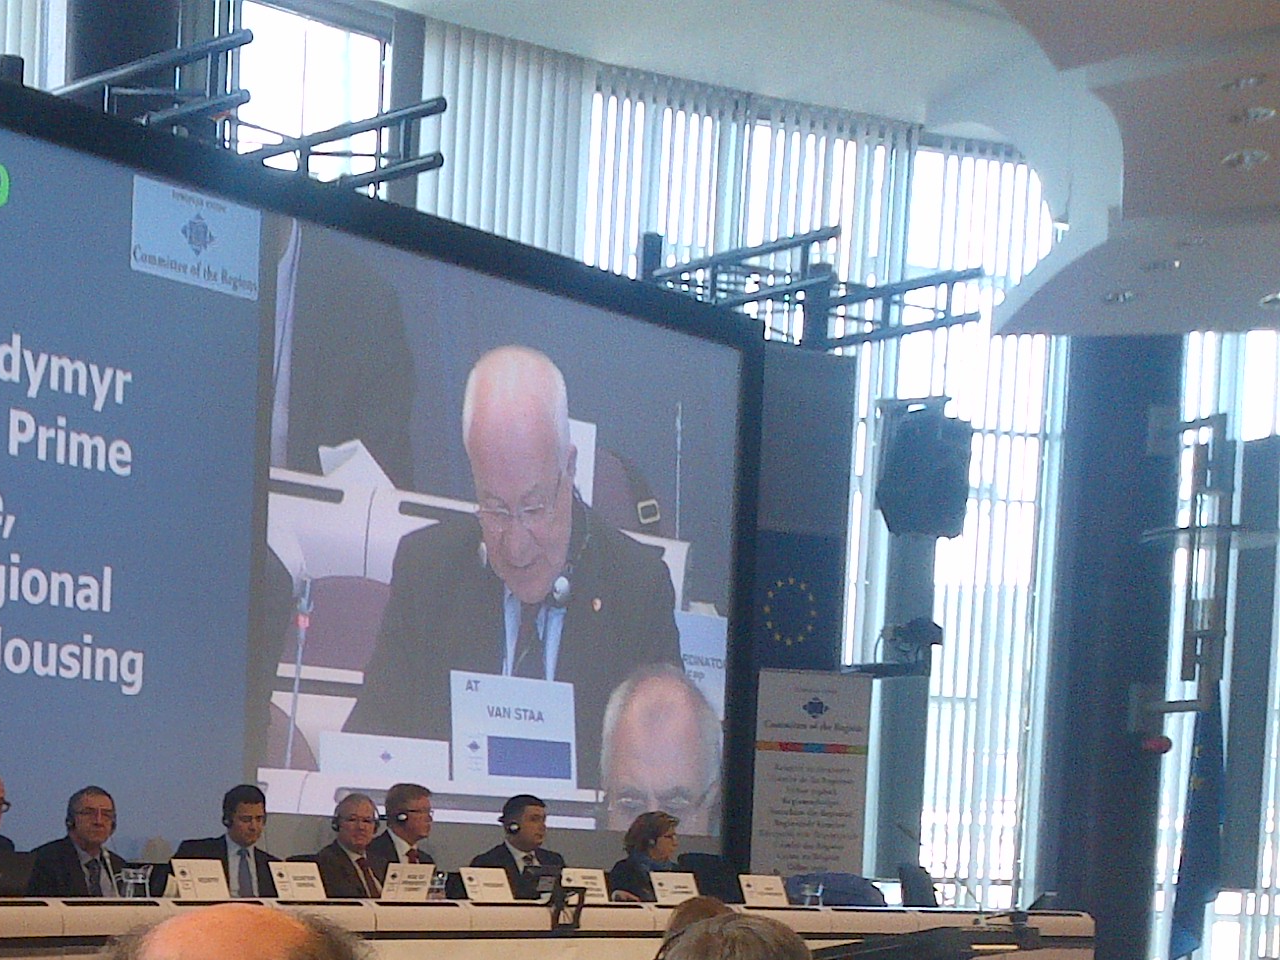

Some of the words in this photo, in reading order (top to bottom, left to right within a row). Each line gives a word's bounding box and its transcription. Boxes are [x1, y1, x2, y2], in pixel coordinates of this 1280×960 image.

[9, 407, 132, 476] Prime
[465, 679, 481, 692] AT
[487, 705, 511, 720] VAN
[514, 707, 545, 722] STAA
